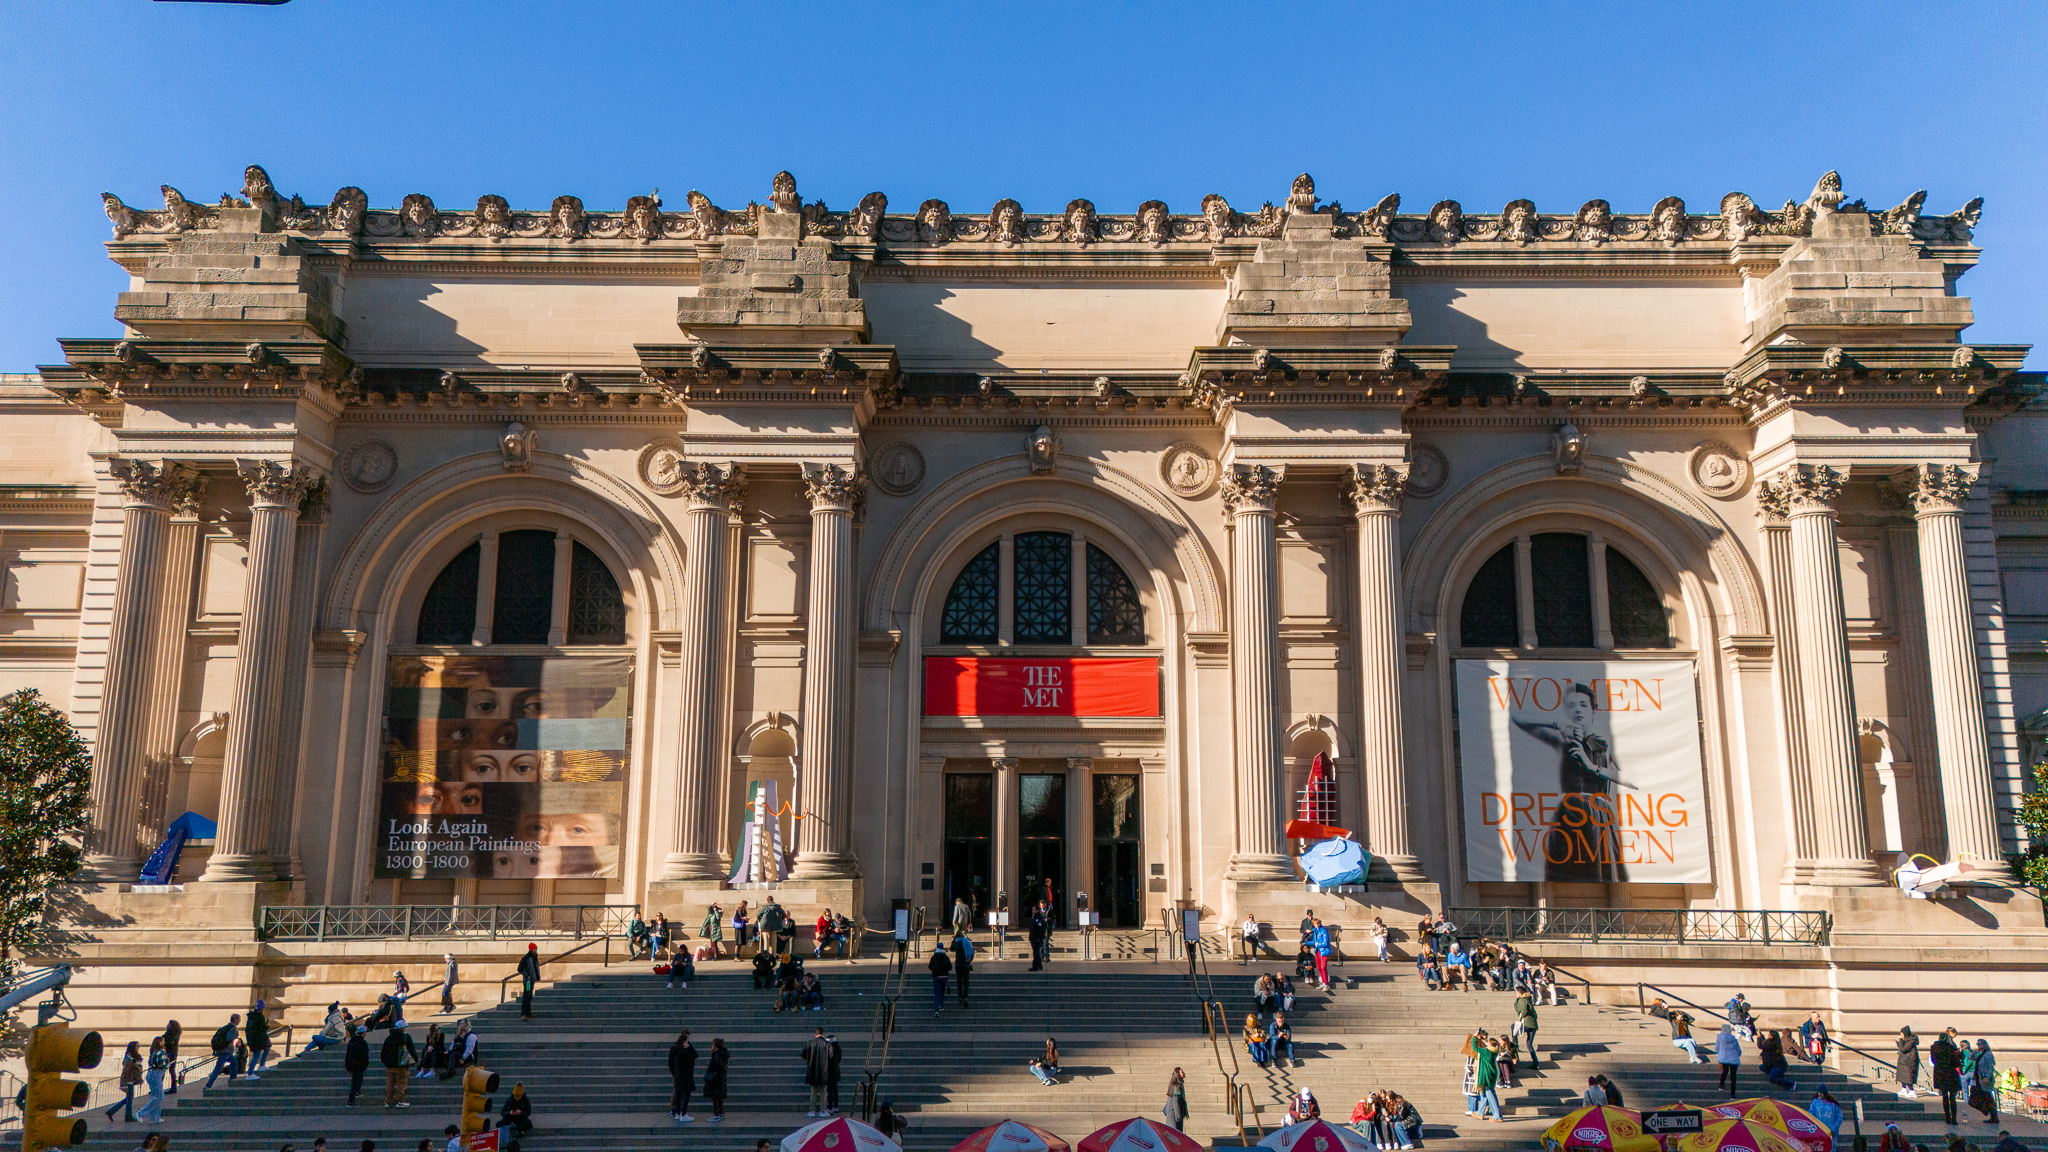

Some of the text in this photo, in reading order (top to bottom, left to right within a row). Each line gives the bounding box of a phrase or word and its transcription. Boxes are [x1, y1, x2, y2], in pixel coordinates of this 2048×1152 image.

[1022, 666, 1062, 686] THE
[1022, 687, 1063, 707] MET
[1481, 792, 1688, 827] DRESSING
[389, 818, 488, 838] Look Again
[387, 836, 542, 856] European Paintings
[1496, 828, 1677, 864] WOMEN
[1650, 1117, 1695, 1127] ONE WAY
[1577, 1129, 1599, 1139] NIKAS
